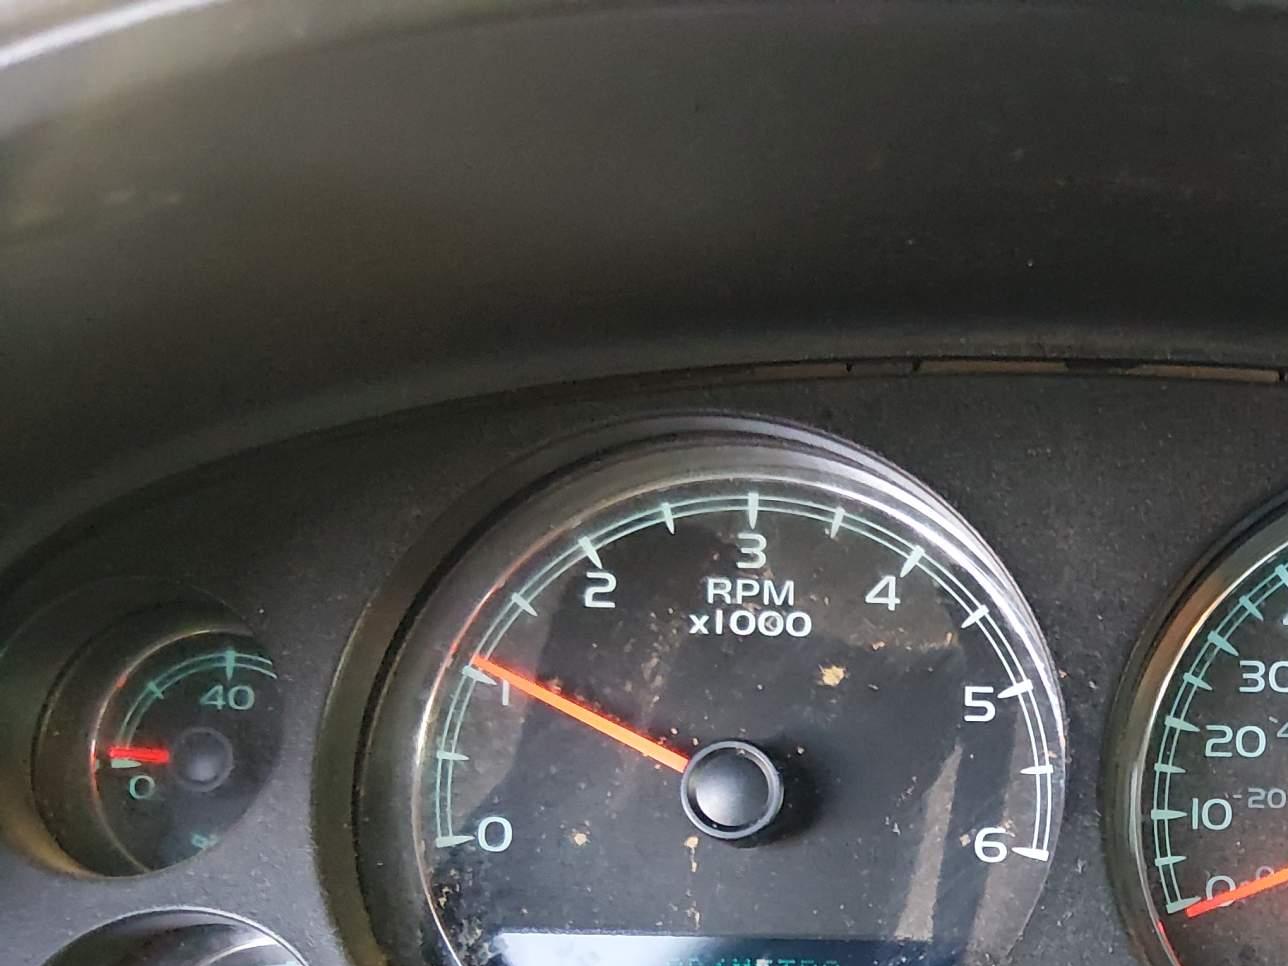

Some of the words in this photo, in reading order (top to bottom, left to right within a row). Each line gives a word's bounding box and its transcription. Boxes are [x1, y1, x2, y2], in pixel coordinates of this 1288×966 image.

[736, 532, 767, 569] 3
[583, 571, 617, 609] 2
[707, 577, 795, 606] RPM
[865, 575, 901, 611] 4
[689, 608, 812, 637] x1000
[201, 684, 255, 710] 40
[964, 685, 996, 722] 5
[1205, 724, 1267, 758] 20
[129, 774, 156, 799] 0
[1247, 787, 1287, 809] 20
[1191, 797, 1233, 831] 10
[477, 816, 513, 852] 0
[974, 826, 1010, 863] 6
